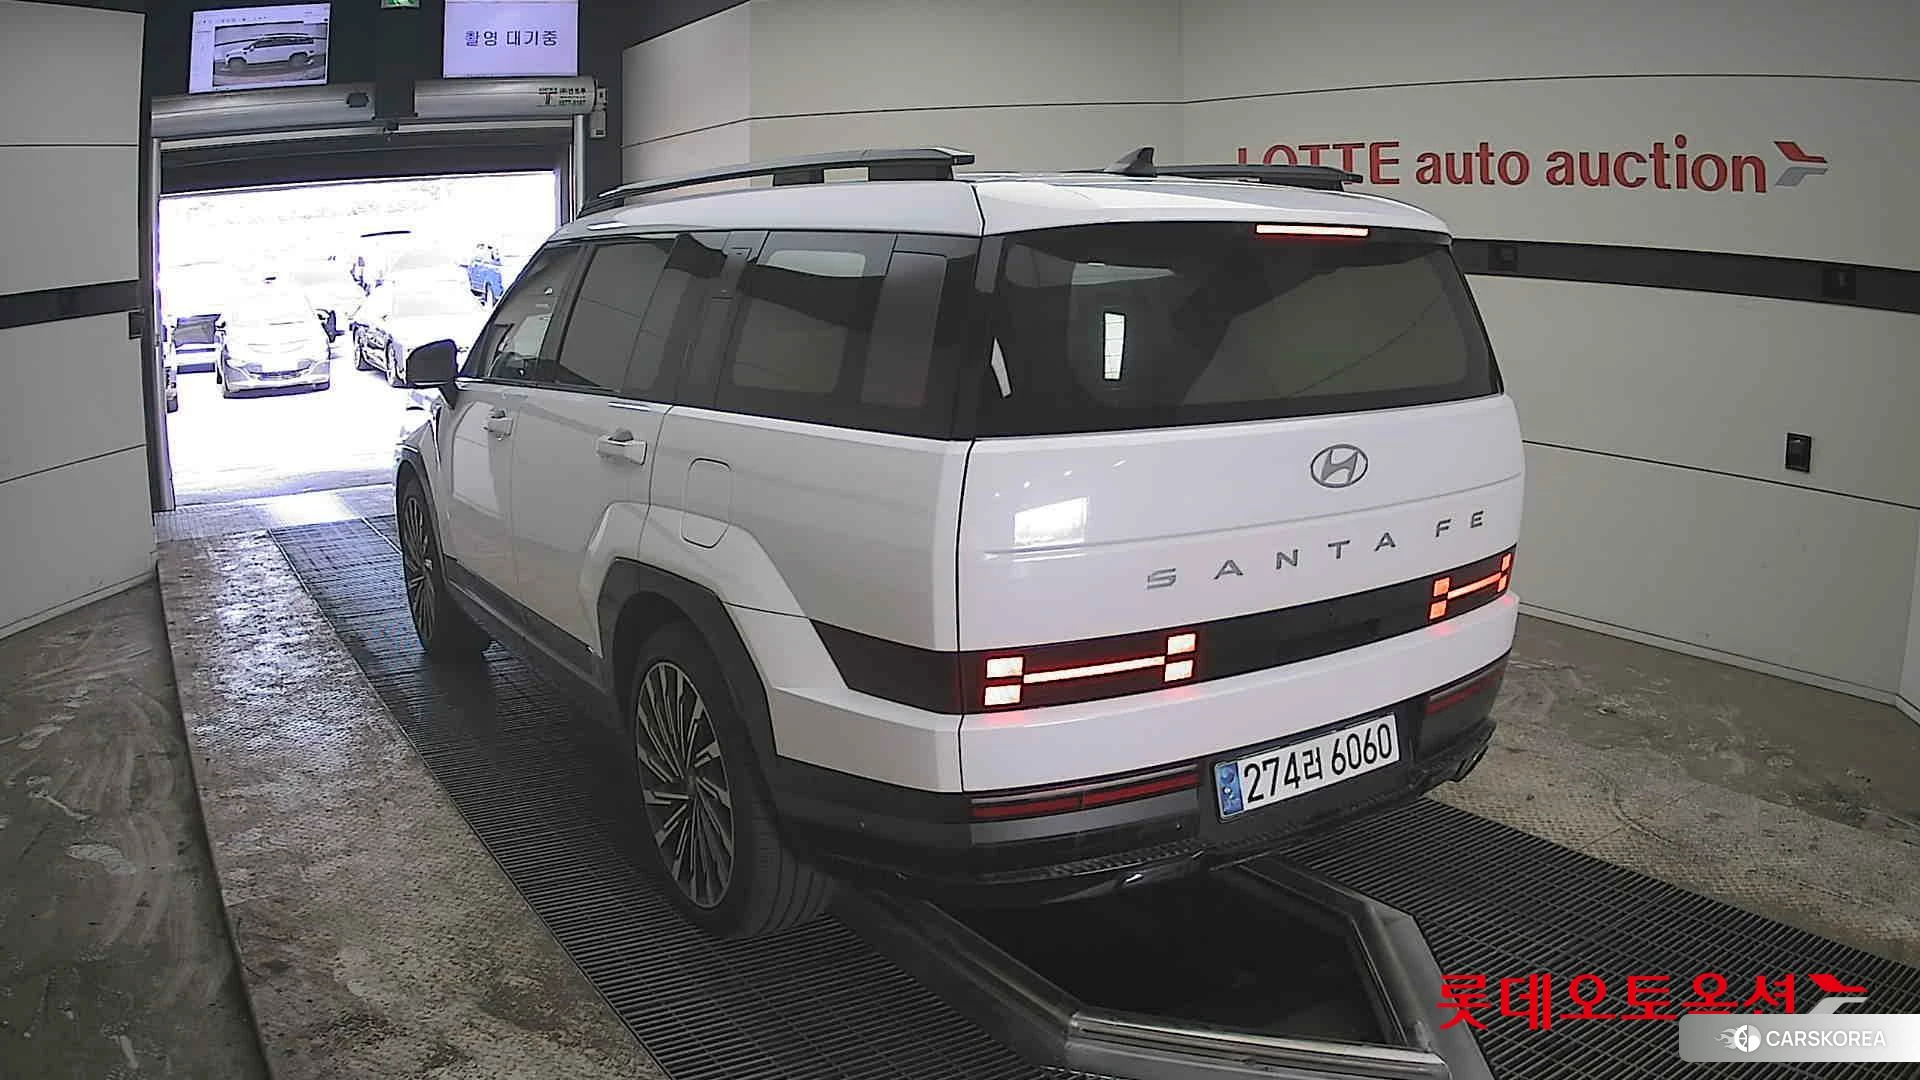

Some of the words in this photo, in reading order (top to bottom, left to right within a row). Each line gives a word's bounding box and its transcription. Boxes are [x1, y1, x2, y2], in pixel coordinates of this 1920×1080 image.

[465, 30, 498, 47] 촬영
[506, 29, 558, 47] 대기중
[1415, 143, 1530, 185] auto
[1545, 134, 1767, 193] auction
[1146, 531, 1396, 591] SANTA
[1434, 510, 1485, 538] FE
[1243, 746, 1324, 804] 274러
[1331, 723, 1393, 776] 6060
